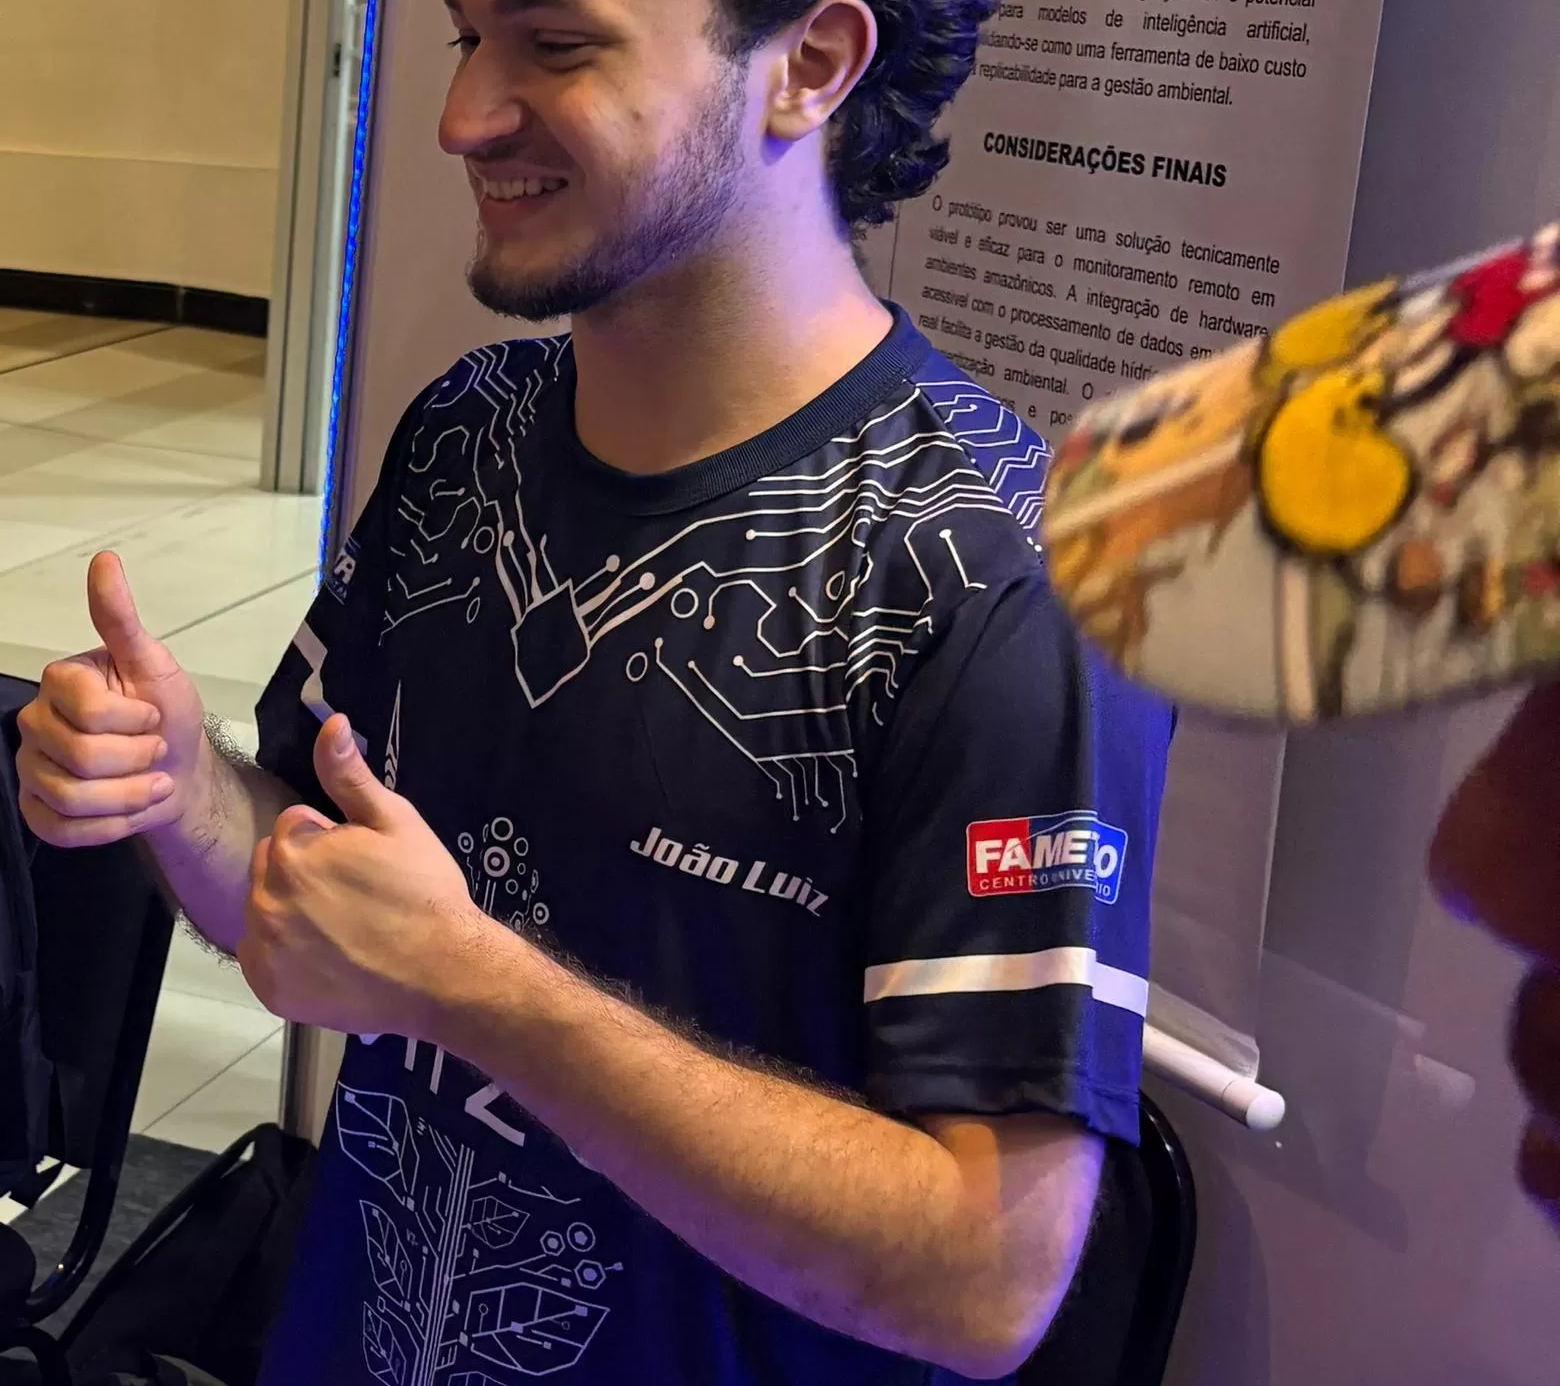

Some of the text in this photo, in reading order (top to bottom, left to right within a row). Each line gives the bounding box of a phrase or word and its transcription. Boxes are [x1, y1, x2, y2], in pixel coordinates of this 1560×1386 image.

[1038, 5, 1310, 46] modelos de inteligência artificial,
[1041, 40, 1307, 79] como uma ferramenta de baixo custo
[1058, 71, 1233, 106] para gestão ambiental.
[983, 132, 1227, 188] CONSIDERAÇÕES FINAIS
[998, 210, 1280, 275] provou ser uma solução tecnicamente
[1017, 245, 1275, 308] para monitoramento remoto em
[983, 267, 1268, 339] amazônicos. A integração de hardware
[984, 331, 1115, 374] gestão da qualidade
[1009, 309, 1183, 358] processamento de dados
[1004, 366, 1070, 395] ambiental.
[630, 826, 829, 917] João Luiz
[980, 874, 1048, 890] CENTRO
